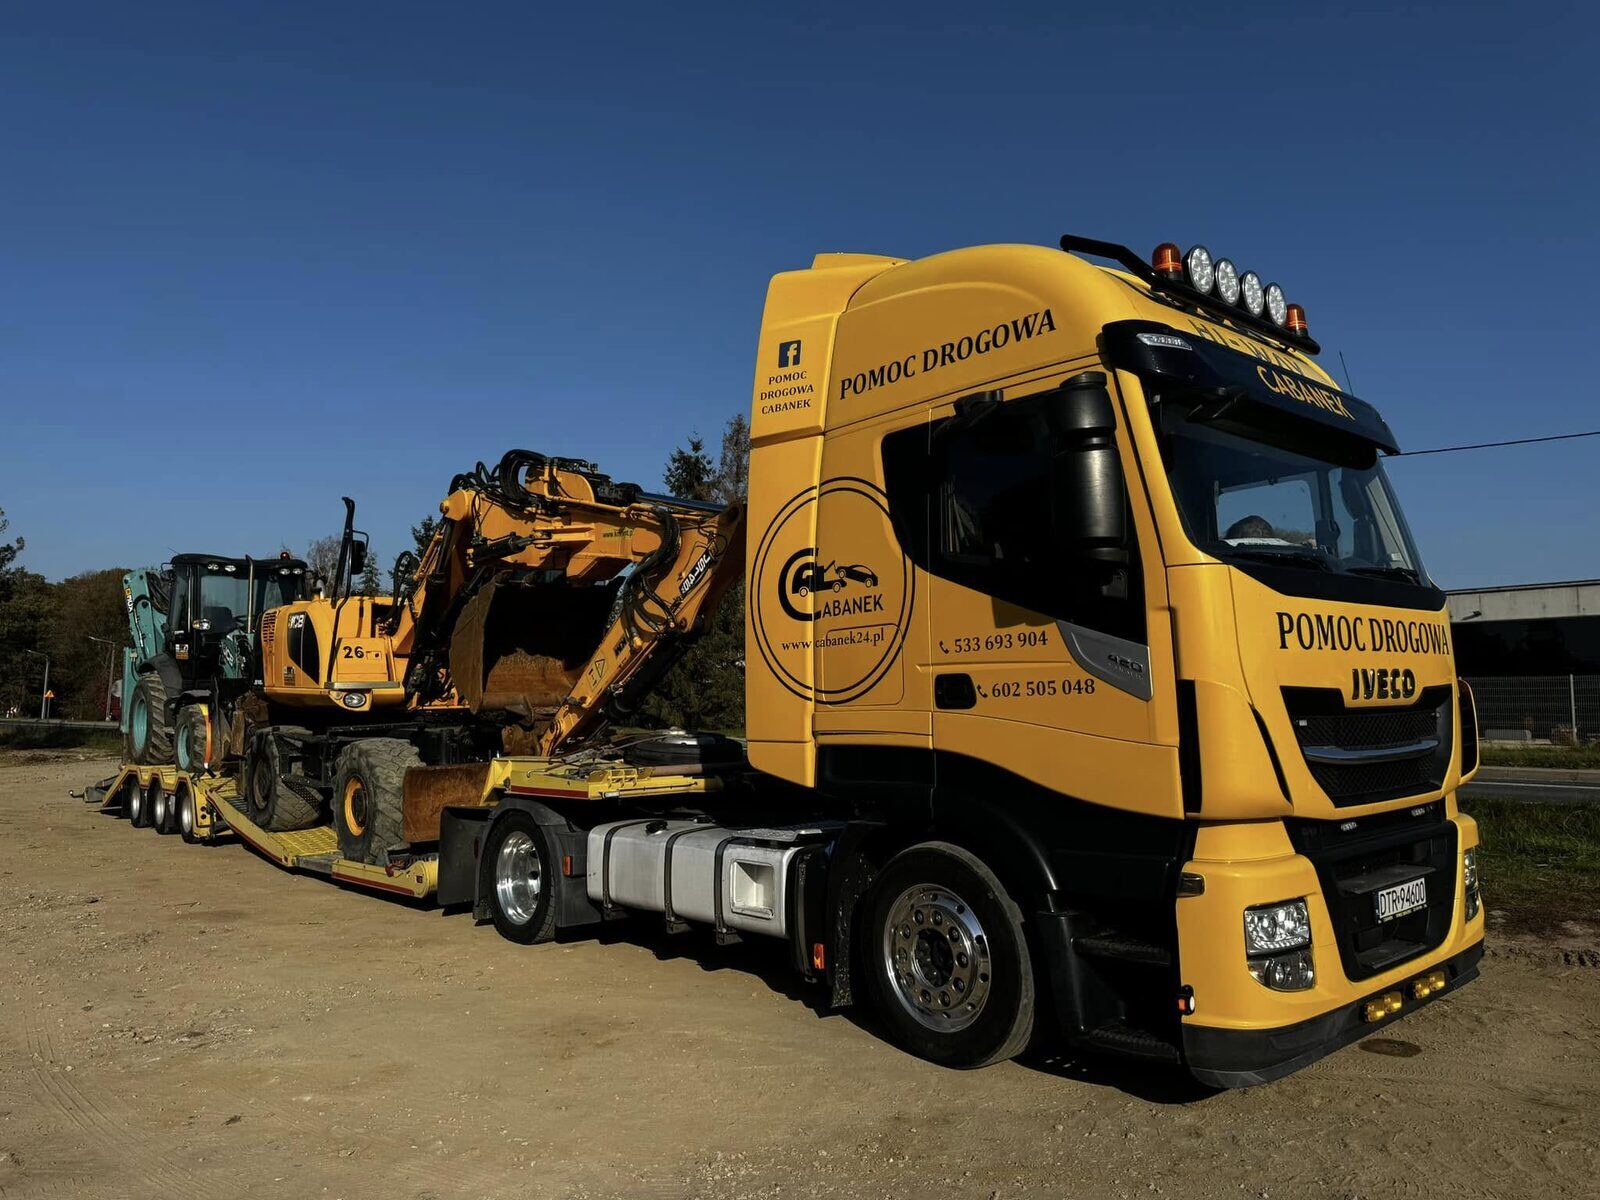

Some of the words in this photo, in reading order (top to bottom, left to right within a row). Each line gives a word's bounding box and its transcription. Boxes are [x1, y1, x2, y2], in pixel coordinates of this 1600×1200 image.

[839, 355, 916, 400] POMOC
[922, 308, 1057, 373] DROGOWA
[768, 370, 807, 385] POMOC
[760, 384, 814, 401] DROGOWA
[1256, 365, 1356, 421] CABANEK
[761, 399, 811, 415] CABANEK
[778, 547, 884, 622] CABANEK
[782, 628, 884, 651] wwwcabanek24.pl
[954, 637, 981, 653] 533
[985, 634, 1013, 651] 693
[1017, 630, 1049, 648] 904
[1275, 611, 1366, 652] POMOC
[1368, 618, 1450, 656] DROGOWA
[343, 645, 365, 659] 26
[991, 682, 1021, 698] 602
[1026, 680, 1057, 697] 505
[1062, 678, 1096, 695] 048
[1351, 668, 1416, 701] IVECO
